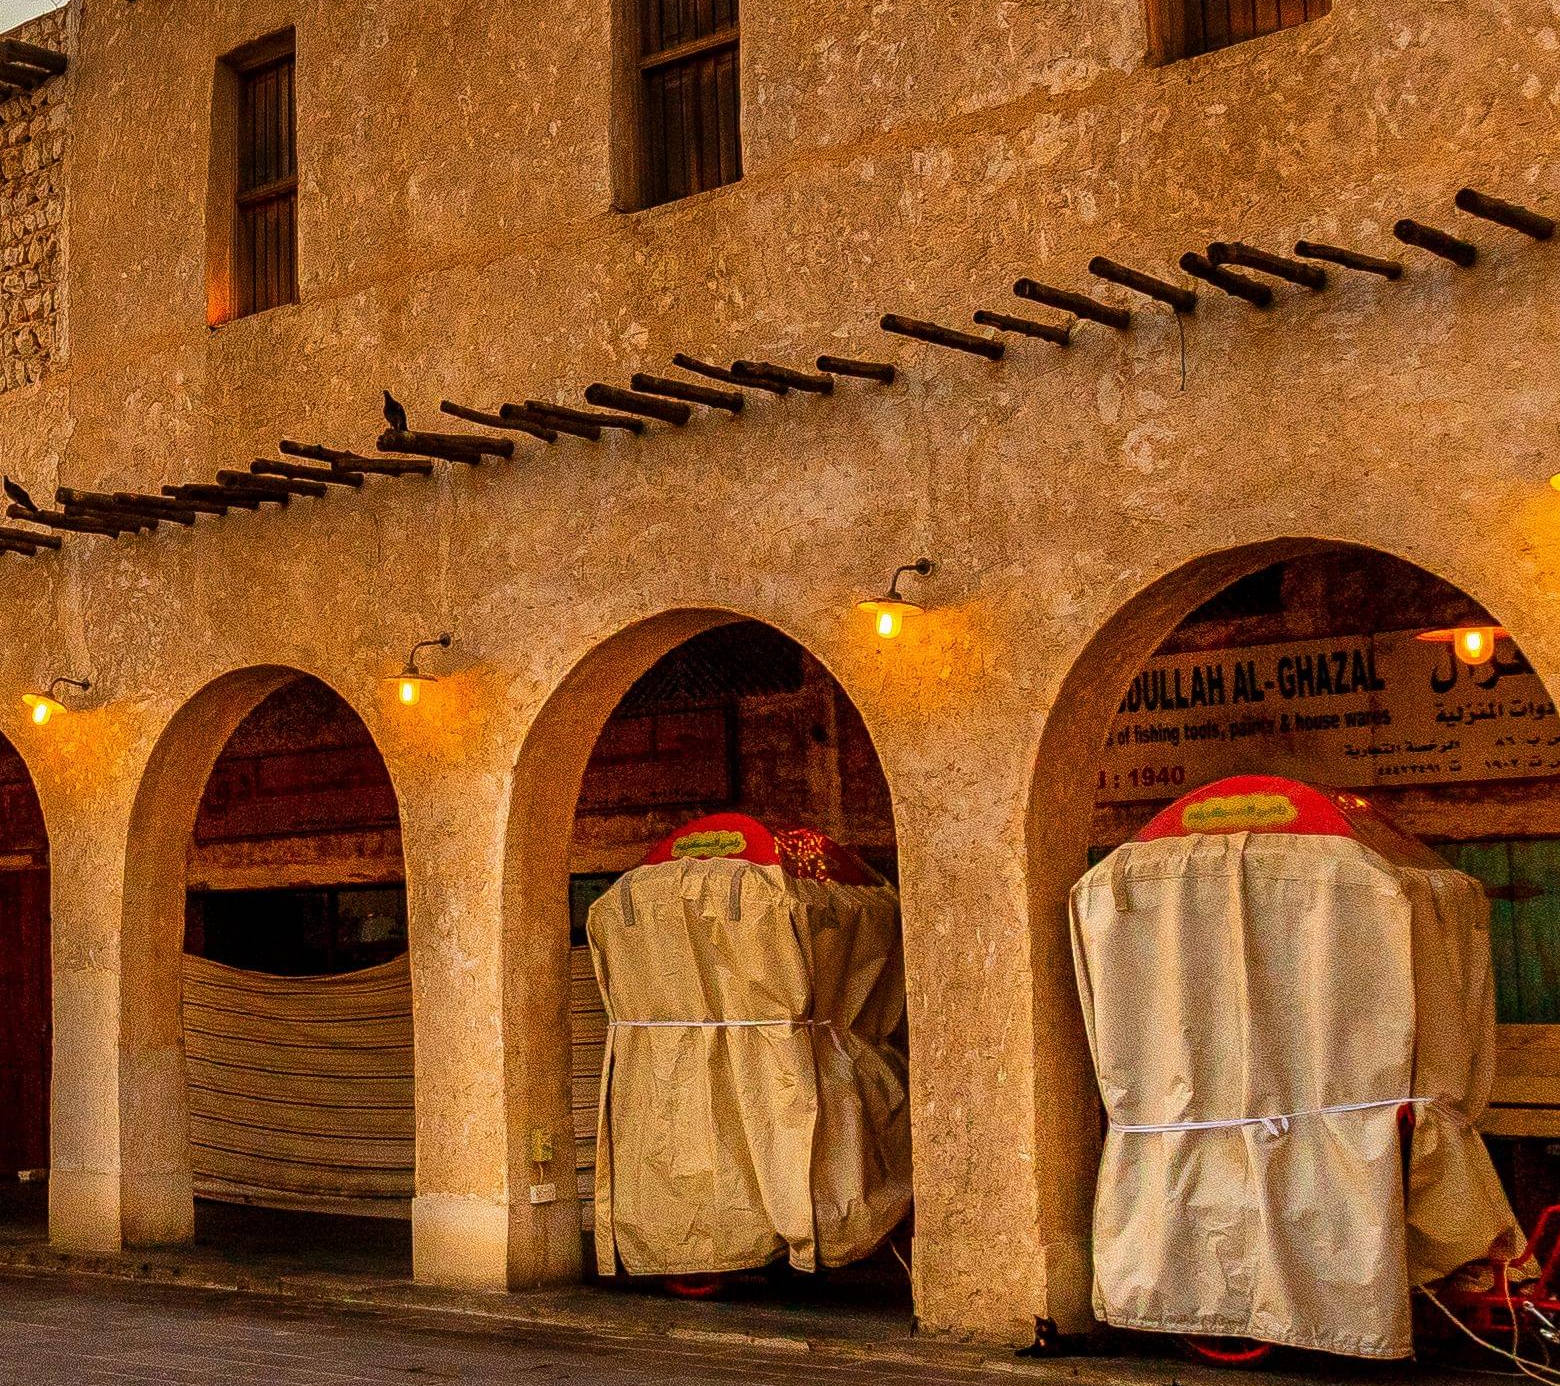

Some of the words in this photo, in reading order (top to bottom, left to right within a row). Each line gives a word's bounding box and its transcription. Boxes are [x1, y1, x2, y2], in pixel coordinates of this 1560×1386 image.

[1118, 665, 1224, 713] DULLAH
[1233, 649, 1384, 703] AL-GHAZAL
[1134, 724, 1180, 746] fishing
[1280, 714, 1290, 733] &
[1295, 712, 1340, 731] house
[1344, 709, 1392, 727] wares
[1435, 702, 1503, 727] المنزلية
[1128, 766, 1185, 787] 1940
